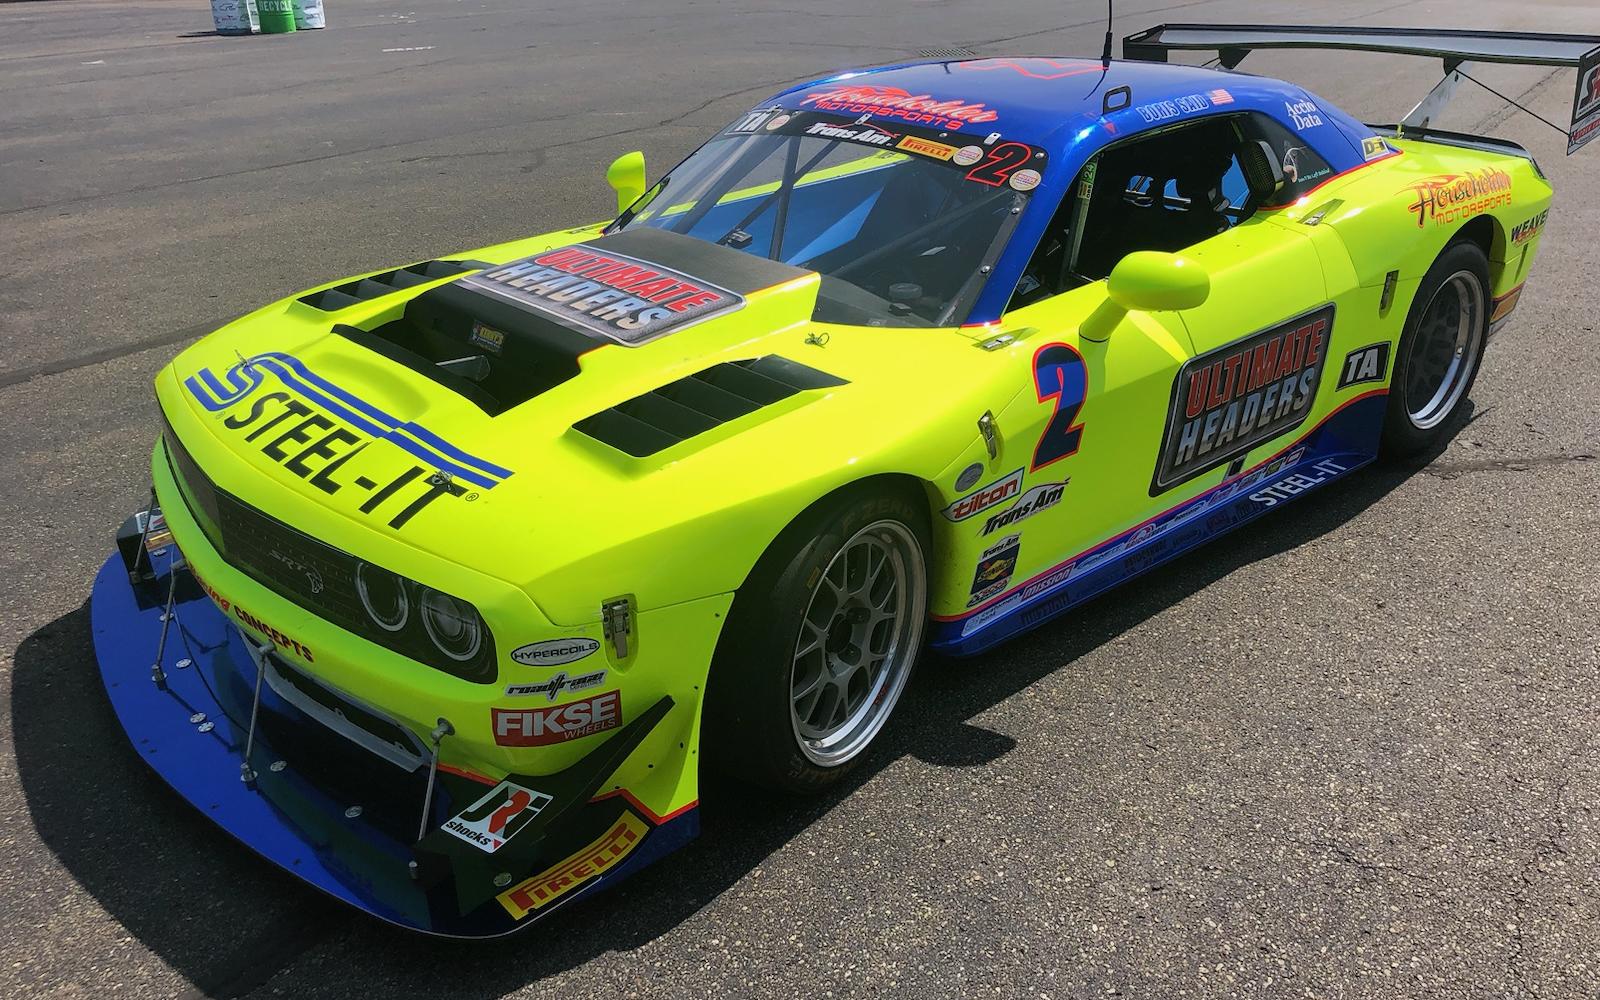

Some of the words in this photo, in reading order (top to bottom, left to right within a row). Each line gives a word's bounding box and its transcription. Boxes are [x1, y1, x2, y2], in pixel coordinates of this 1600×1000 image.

[815, 101, 964, 130] MOTORSPORTS
[1136, 101, 1181, 122] BORIS
[1174, 94, 1209, 114] SAID
[1285, 99, 1316, 116] Accio
[1292, 114, 1323, 131] Data
[805, 122, 858, 138] Trans
[903, 138, 953, 158] PIRELLI
[965, 142, 1032, 187] 2
[1436, 193, 1512, 227] MOTORSPORTS
[486, 262, 673, 330] HEADERS
[534, 247, 721, 313] ULTIMATE
[1186, 319, 1326, 419] ULTIMATE
[1345, 348, 1379, 383] TA
[1030, 342, 1088, 473] 2
[1175, 367, 1315, 466] HEADERS
[223, 392, 470, 531] STEEL-IT
[953, 479, 1018, 518] tilton
[1249, 459, 1347, 506] STEEL-IT
[982, 501, 1033, 537] Trans
[1030, 486, 1065, 512] Am
[1022, 567, 1072, 600] mission
[233, 605, 315, 663] CONCEPTS
[513, 642, 597, 660] HYPERCOILS
[497, 694, 617, 737] FIKSE
[564, 720, 616, 739] WHEELS
[446, 821, 491, 846] shocks
[508, 822, 638, 911] PIRELLI
